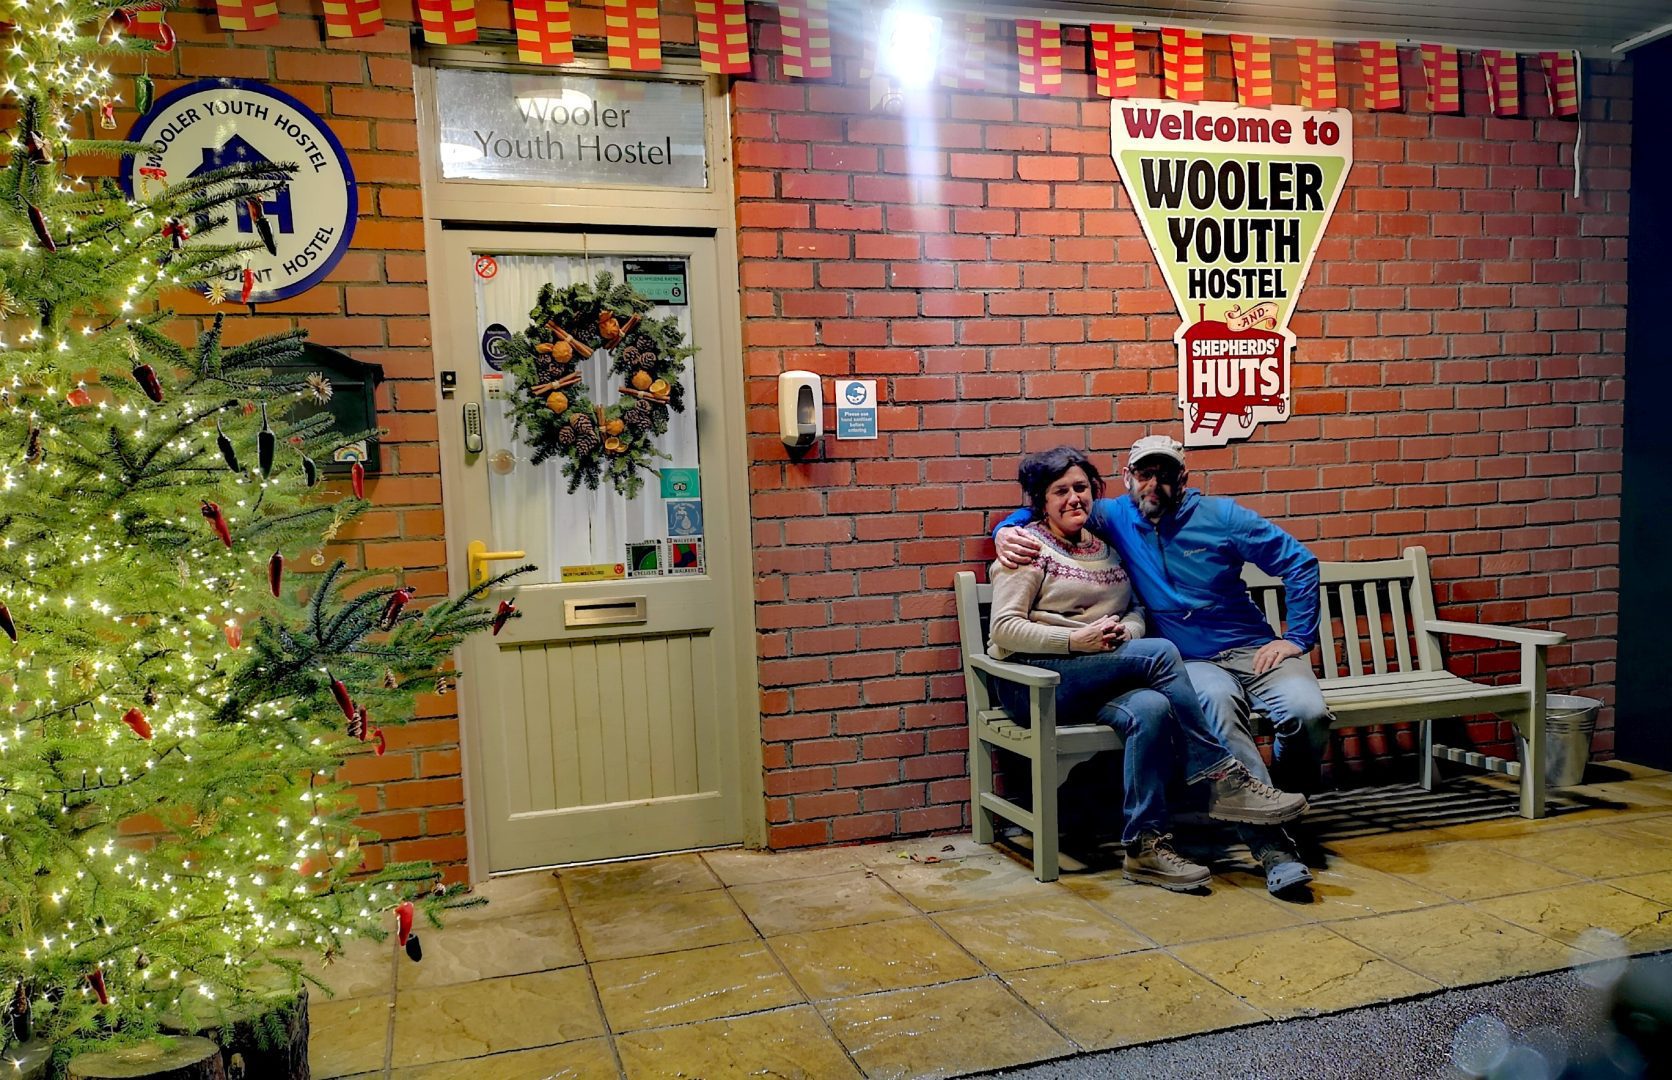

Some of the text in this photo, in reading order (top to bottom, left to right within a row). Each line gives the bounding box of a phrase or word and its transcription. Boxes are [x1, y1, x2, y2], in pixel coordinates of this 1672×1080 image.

[513, 95, 631, 128] Wooler
[1121, 107, 1340, 146] Welcome to
[145, 100, 328, 173] WOOLER YOUTH HOSTEL
[473, 130, 672, 165] Youth Hostel
[1140, 158, 1325, 212] WOOLER
[282, 225, 334, 276] HOSTEL
[1167, 217, 1301, 264] YOUTH
[1188, 268, 1287, 299] HOSTEL
[1241, 307, 1266, 328] AND
[1191, 338, 1280, 357] SHEPHERDS'
[1192, 357, 1281, 398] HUTS
